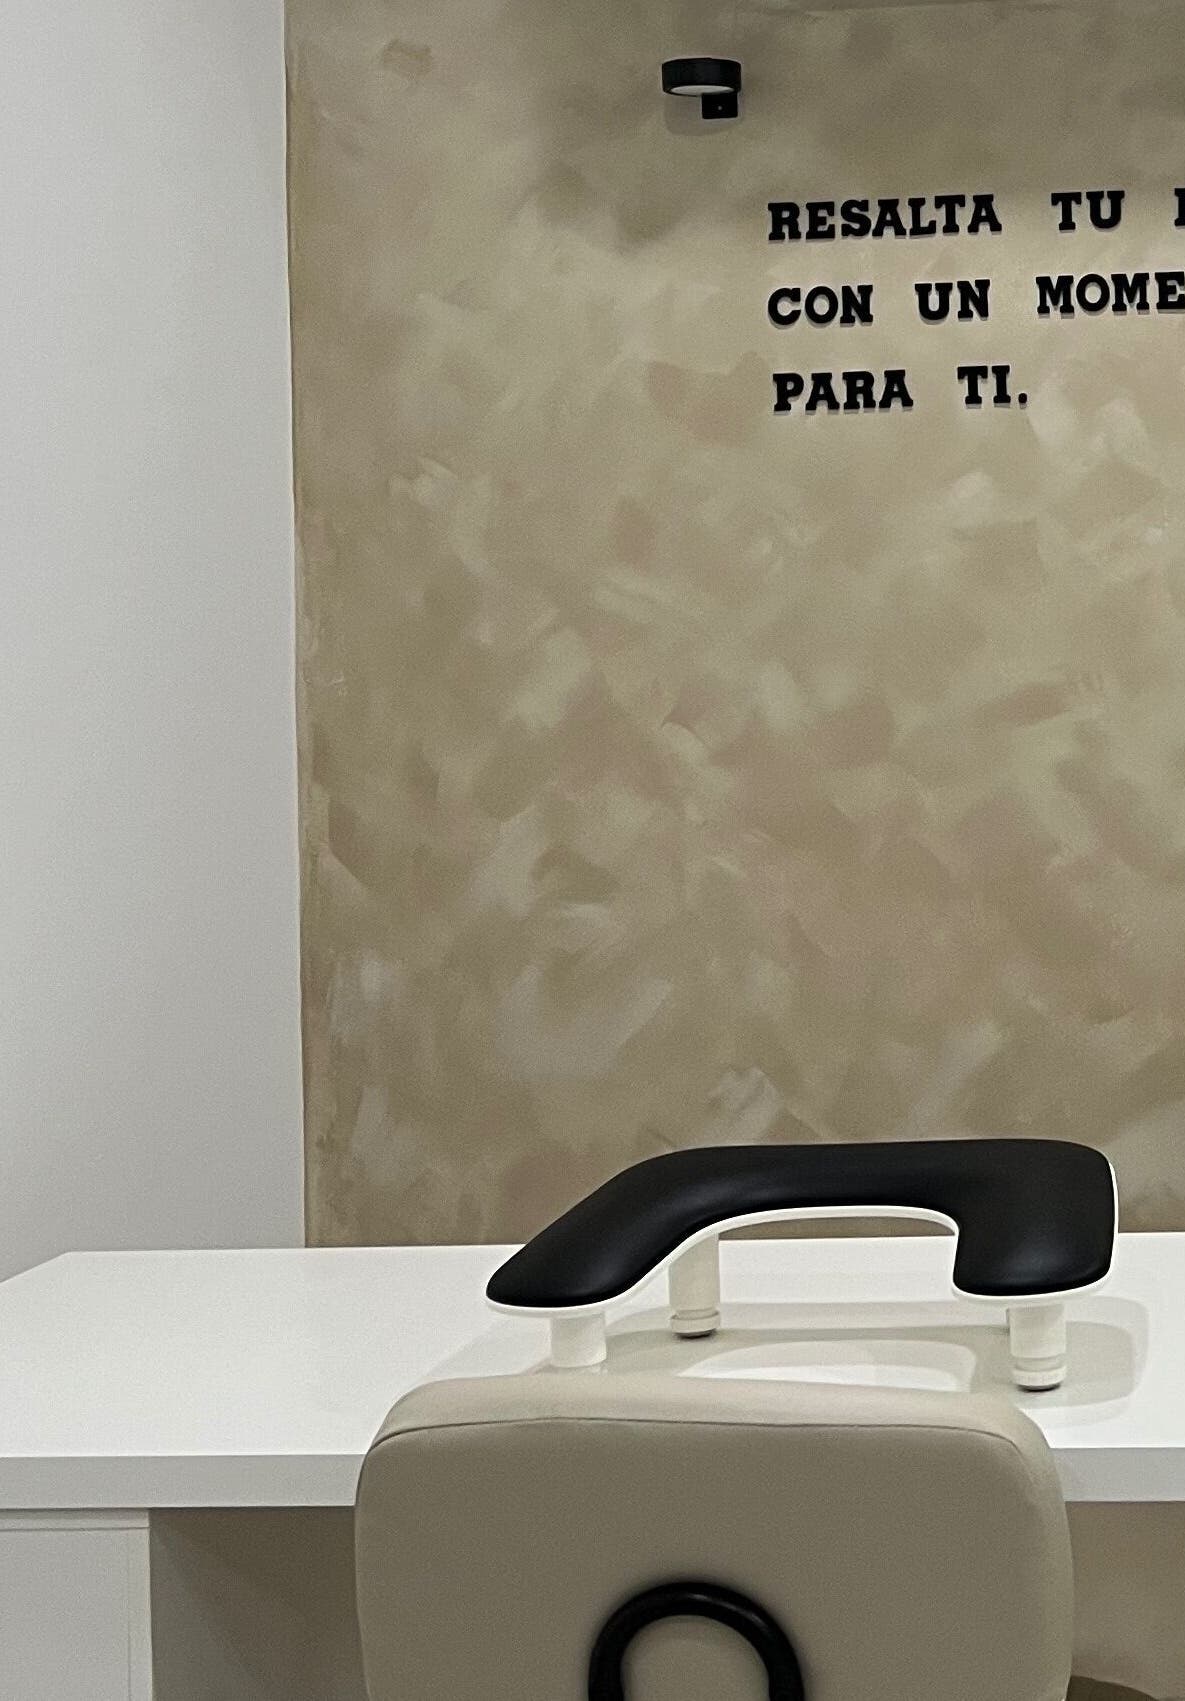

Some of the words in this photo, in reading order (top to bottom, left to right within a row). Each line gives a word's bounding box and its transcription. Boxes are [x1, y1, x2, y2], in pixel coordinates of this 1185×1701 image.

[767, 193, 1003, 241] RESALTA
[1050, 190, 1126, 231] TU
[767, 284, 874, 326] CON
[914, 279, 991, 321] UN
[772, 369, 914, 412] PARA
[957, 365, 1029, 405] TI.
